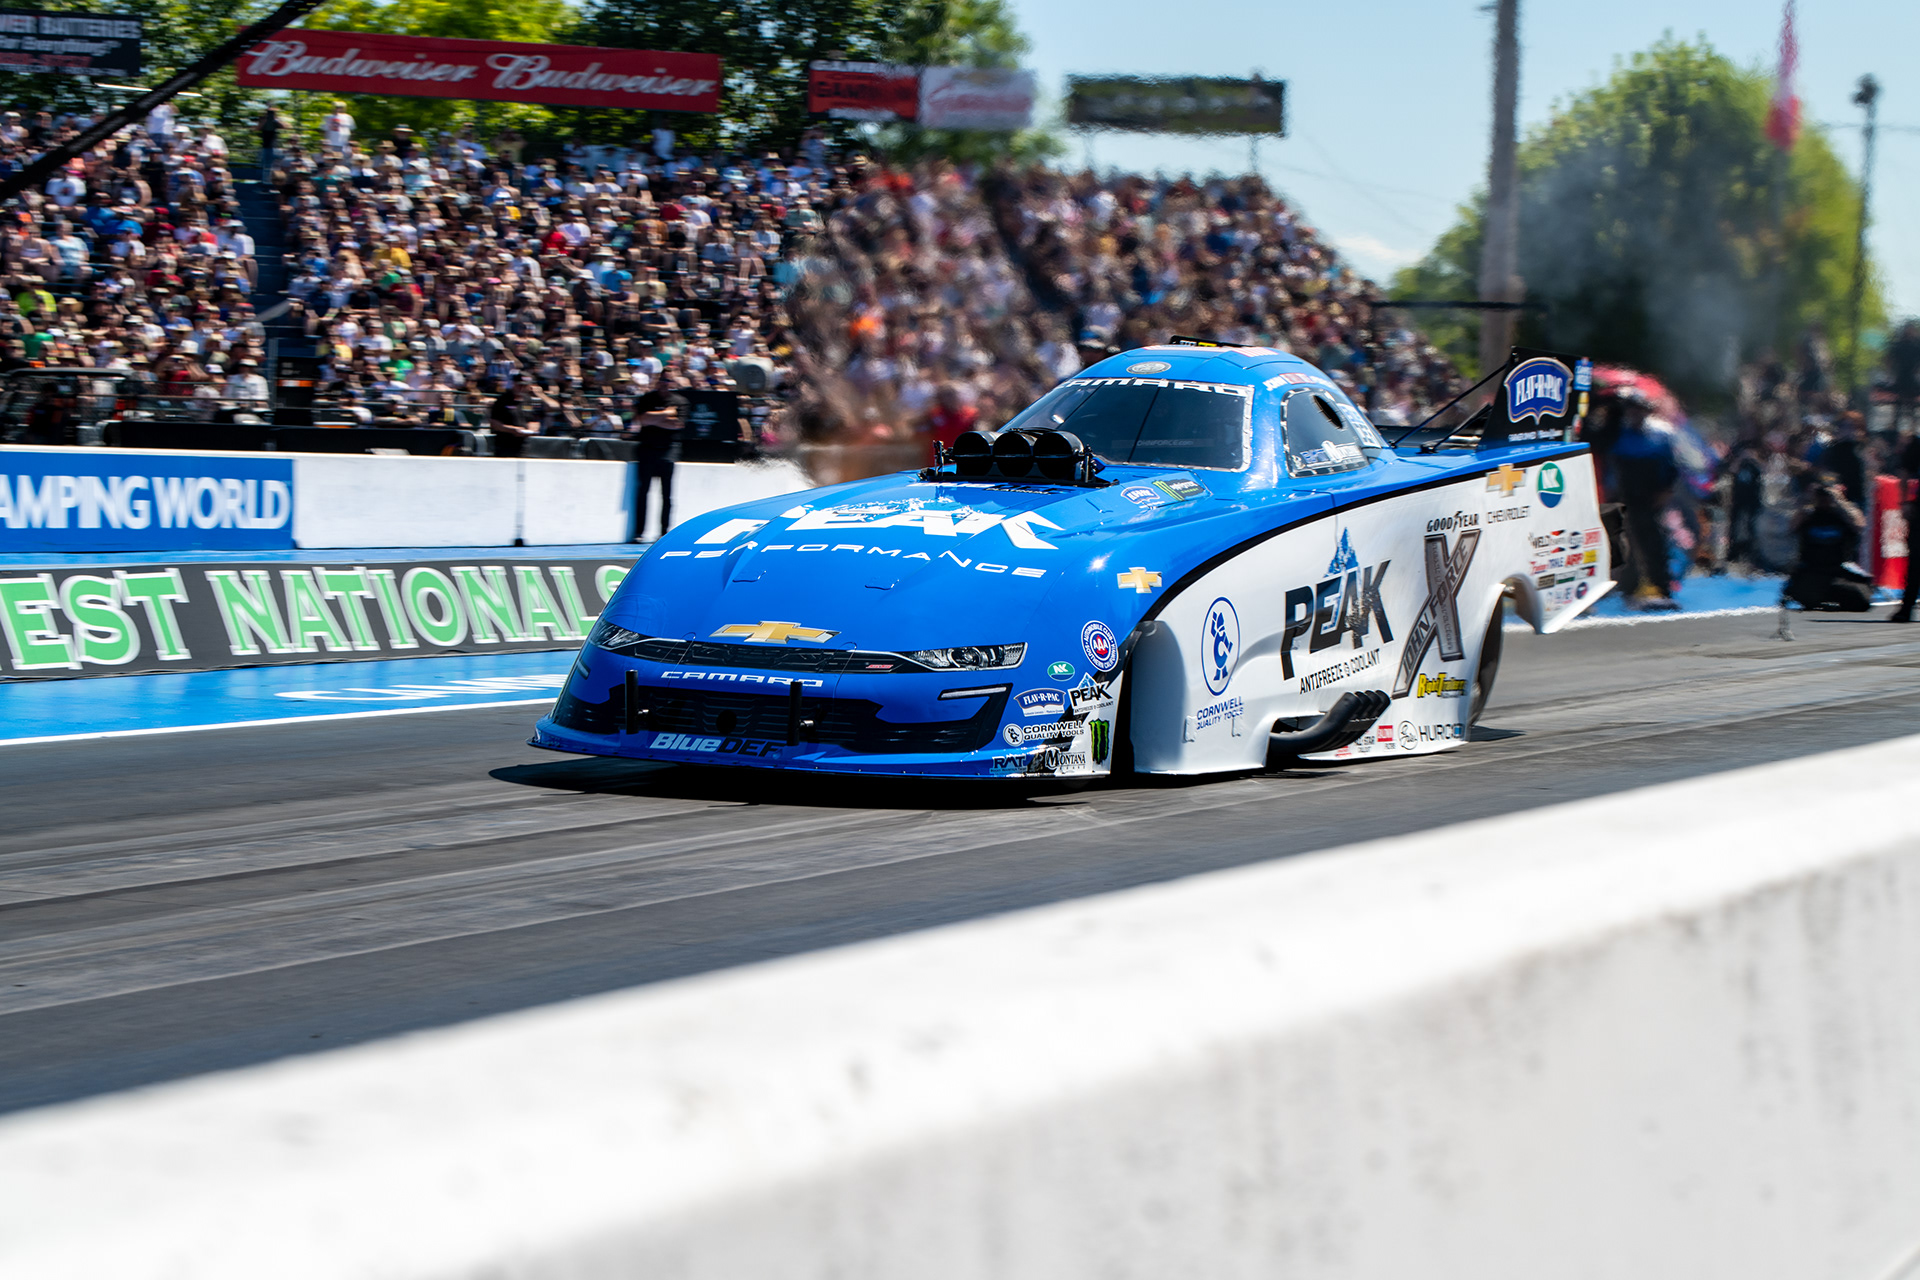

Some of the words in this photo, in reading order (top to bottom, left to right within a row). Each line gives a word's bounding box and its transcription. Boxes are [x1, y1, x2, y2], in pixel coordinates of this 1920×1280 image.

[245, 40, 478, 82] Budweiser
[486, 53, 717, 96] Budweiser
[151, 476, 291, 530] WORLD
[1487, 505, 1530, 524] CHEVROLET
[659, 541, 1047, 579] PERFORMANCE
[1280, 559, 1394, 681] PEAK
[1403, 612, 1431, 685] JOHN
[1428, 539, 1468, 620] FORCE
[661, 671, 824, 687] CAMARO
[1053, 664, 1069, 674] NK
[1300, 663, 1344, 695] ANTIFREEZE
[1350, 648, 1380, 674] COOLANT
[1069, 682, 1113, 707] PEAK
[1196, 696, 1244, 720] CORNWELL
[1023, 720, 1084, 735] CORNWELL
[1024, 732, 1059, 740] QUALITY
[1062, 728, 1085, 737] TOOLS
[1418, 723, 1464, 742] HURCO
[650, 732, 786, 758] BlueDEF
[1046, 747, 1086, 769] MONTANA
